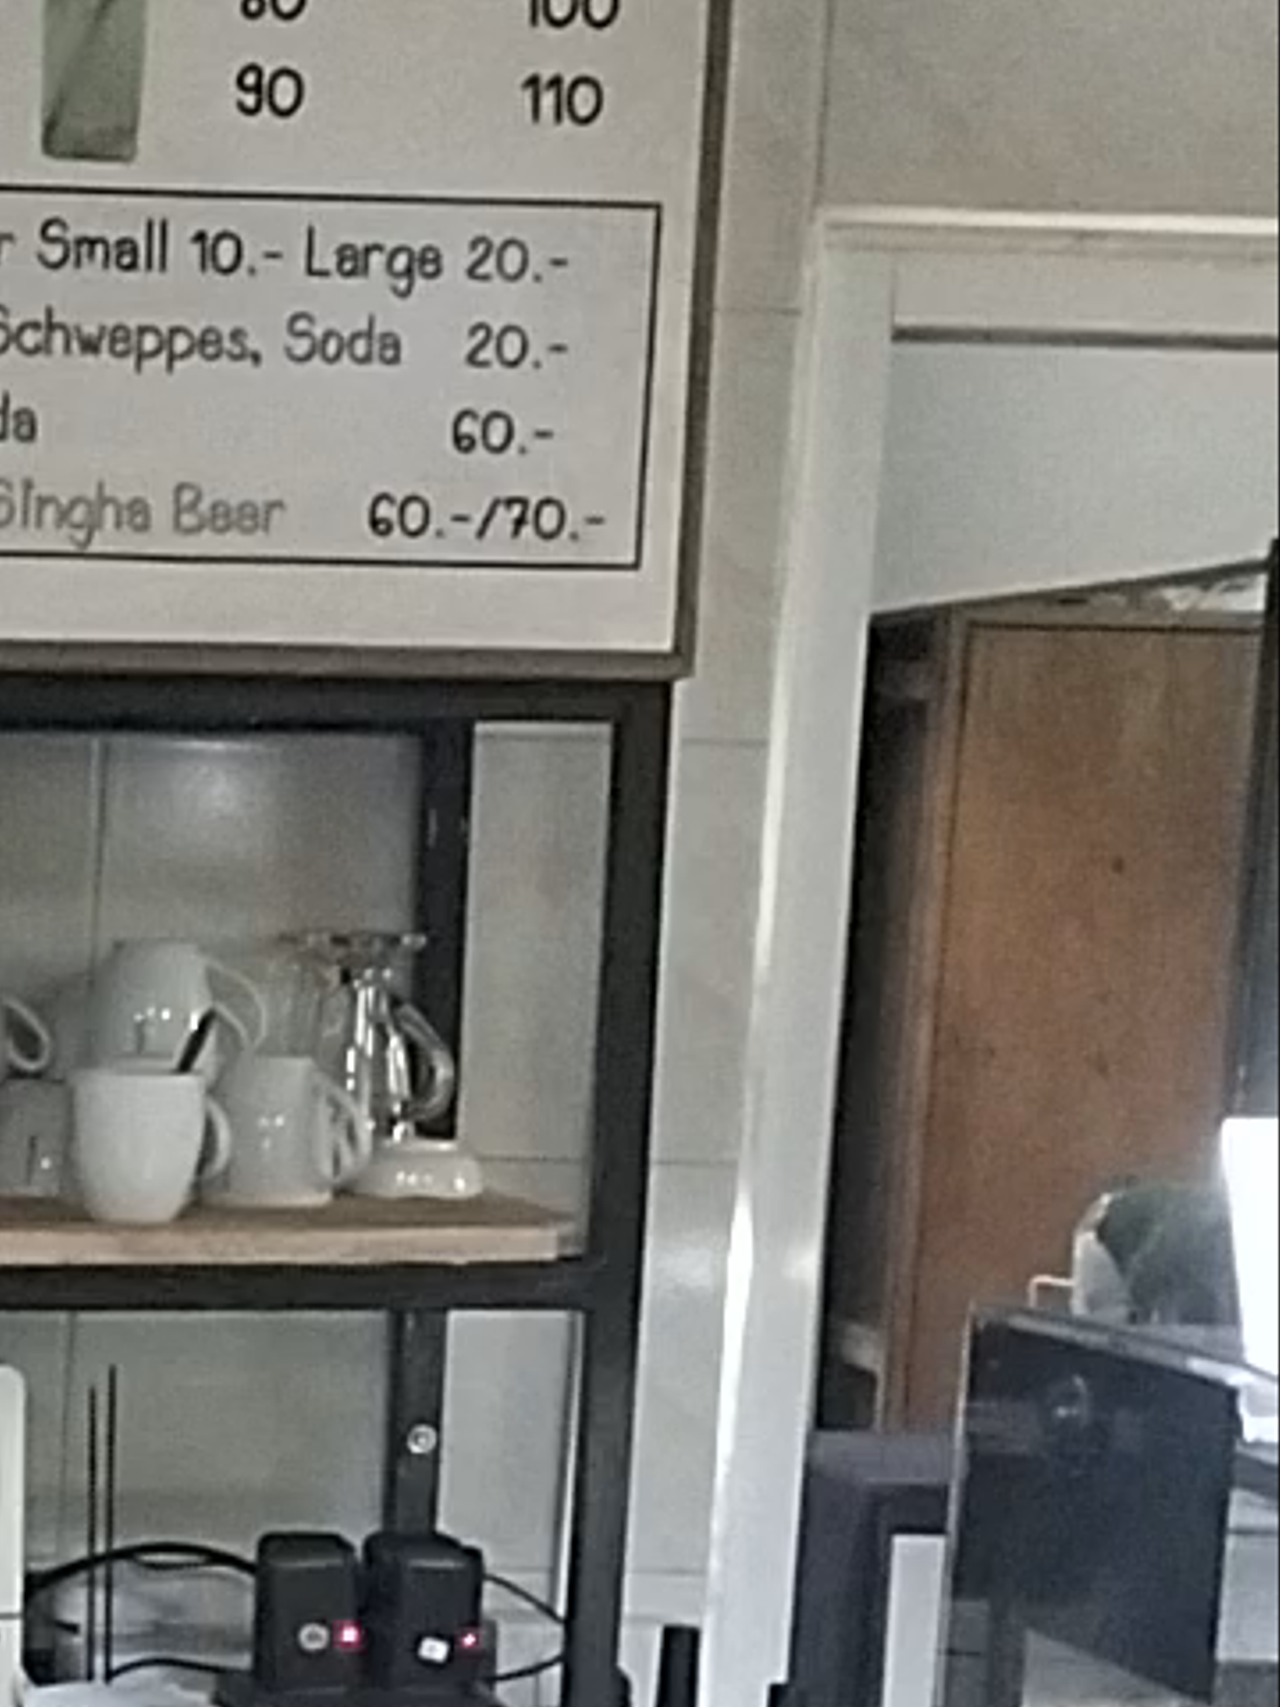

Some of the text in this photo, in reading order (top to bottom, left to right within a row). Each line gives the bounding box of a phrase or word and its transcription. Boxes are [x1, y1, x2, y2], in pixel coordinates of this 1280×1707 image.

[235, 62, 305, 119] 90
[521, 73, 604, 127] 110
[36, 216, 169, 273] Small
[305, 224, 443, 300] Large
[284, 311, 401, 366] Soda
[173, 482, 286, 535] Beer
